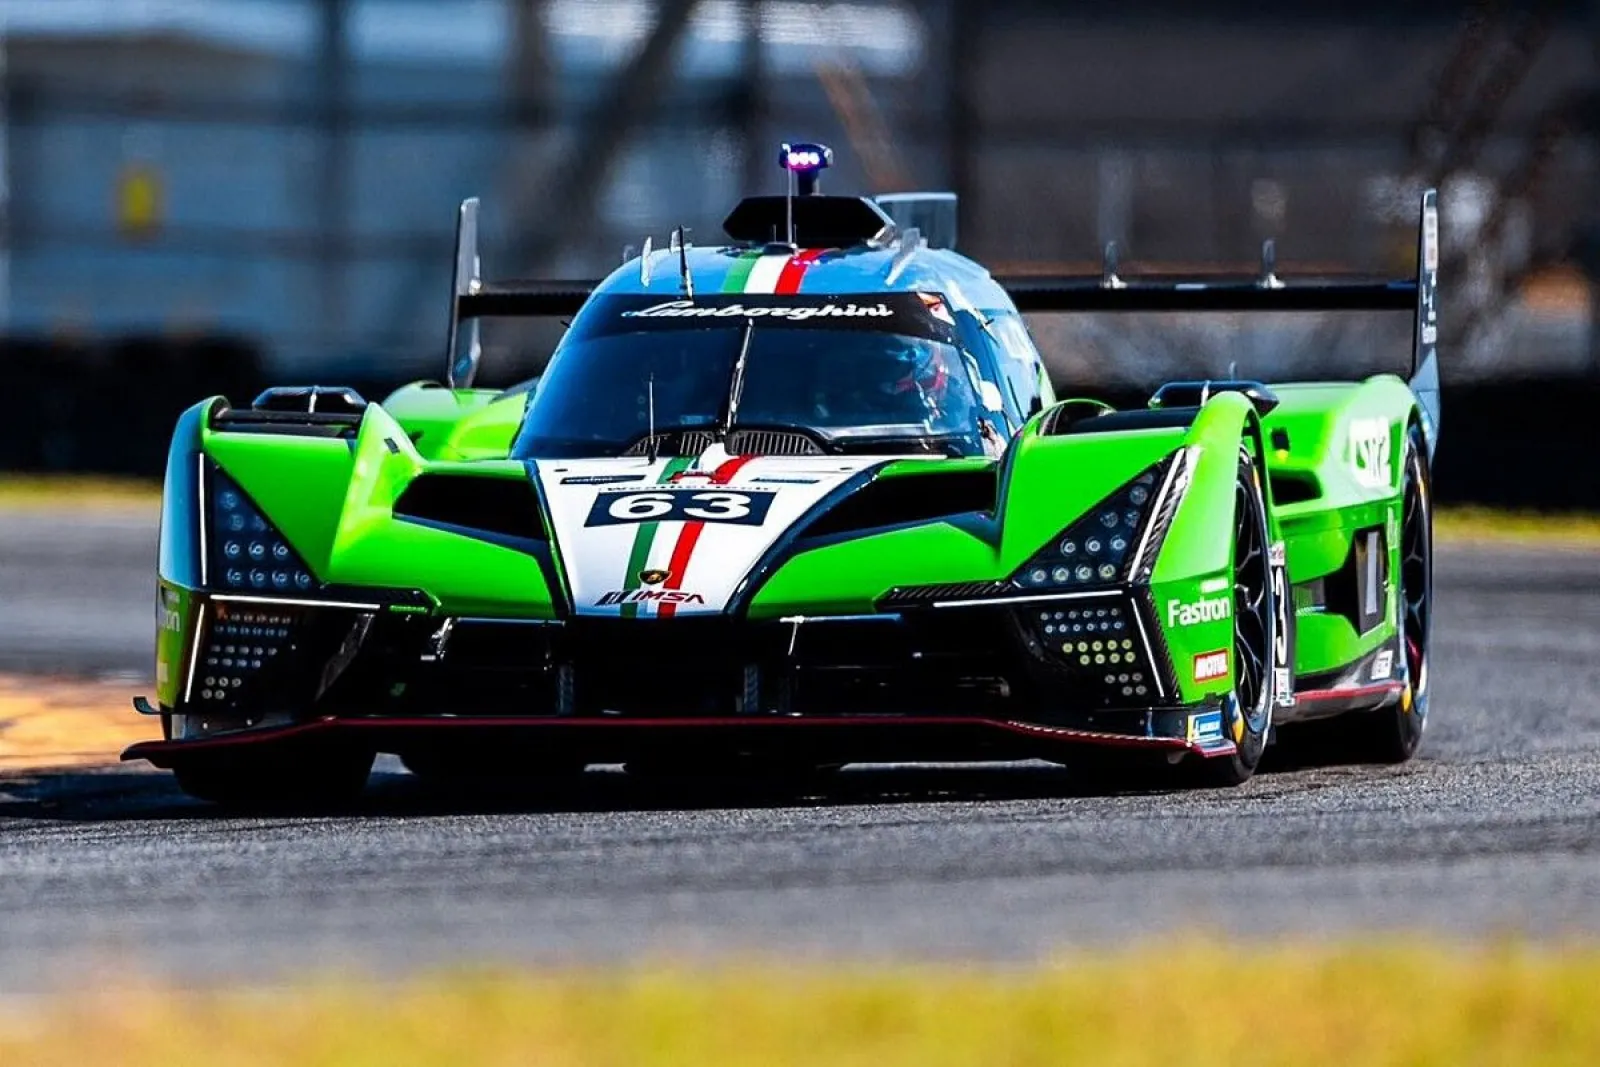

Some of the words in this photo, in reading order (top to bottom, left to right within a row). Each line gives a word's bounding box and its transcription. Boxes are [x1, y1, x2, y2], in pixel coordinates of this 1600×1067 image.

[620, 300, 895, 321] Lamborghini
[608, 492, 753, 521] 63
[632, 590, 705, 605] IMSA
[1167, 596, 1231, 628] Fastron
